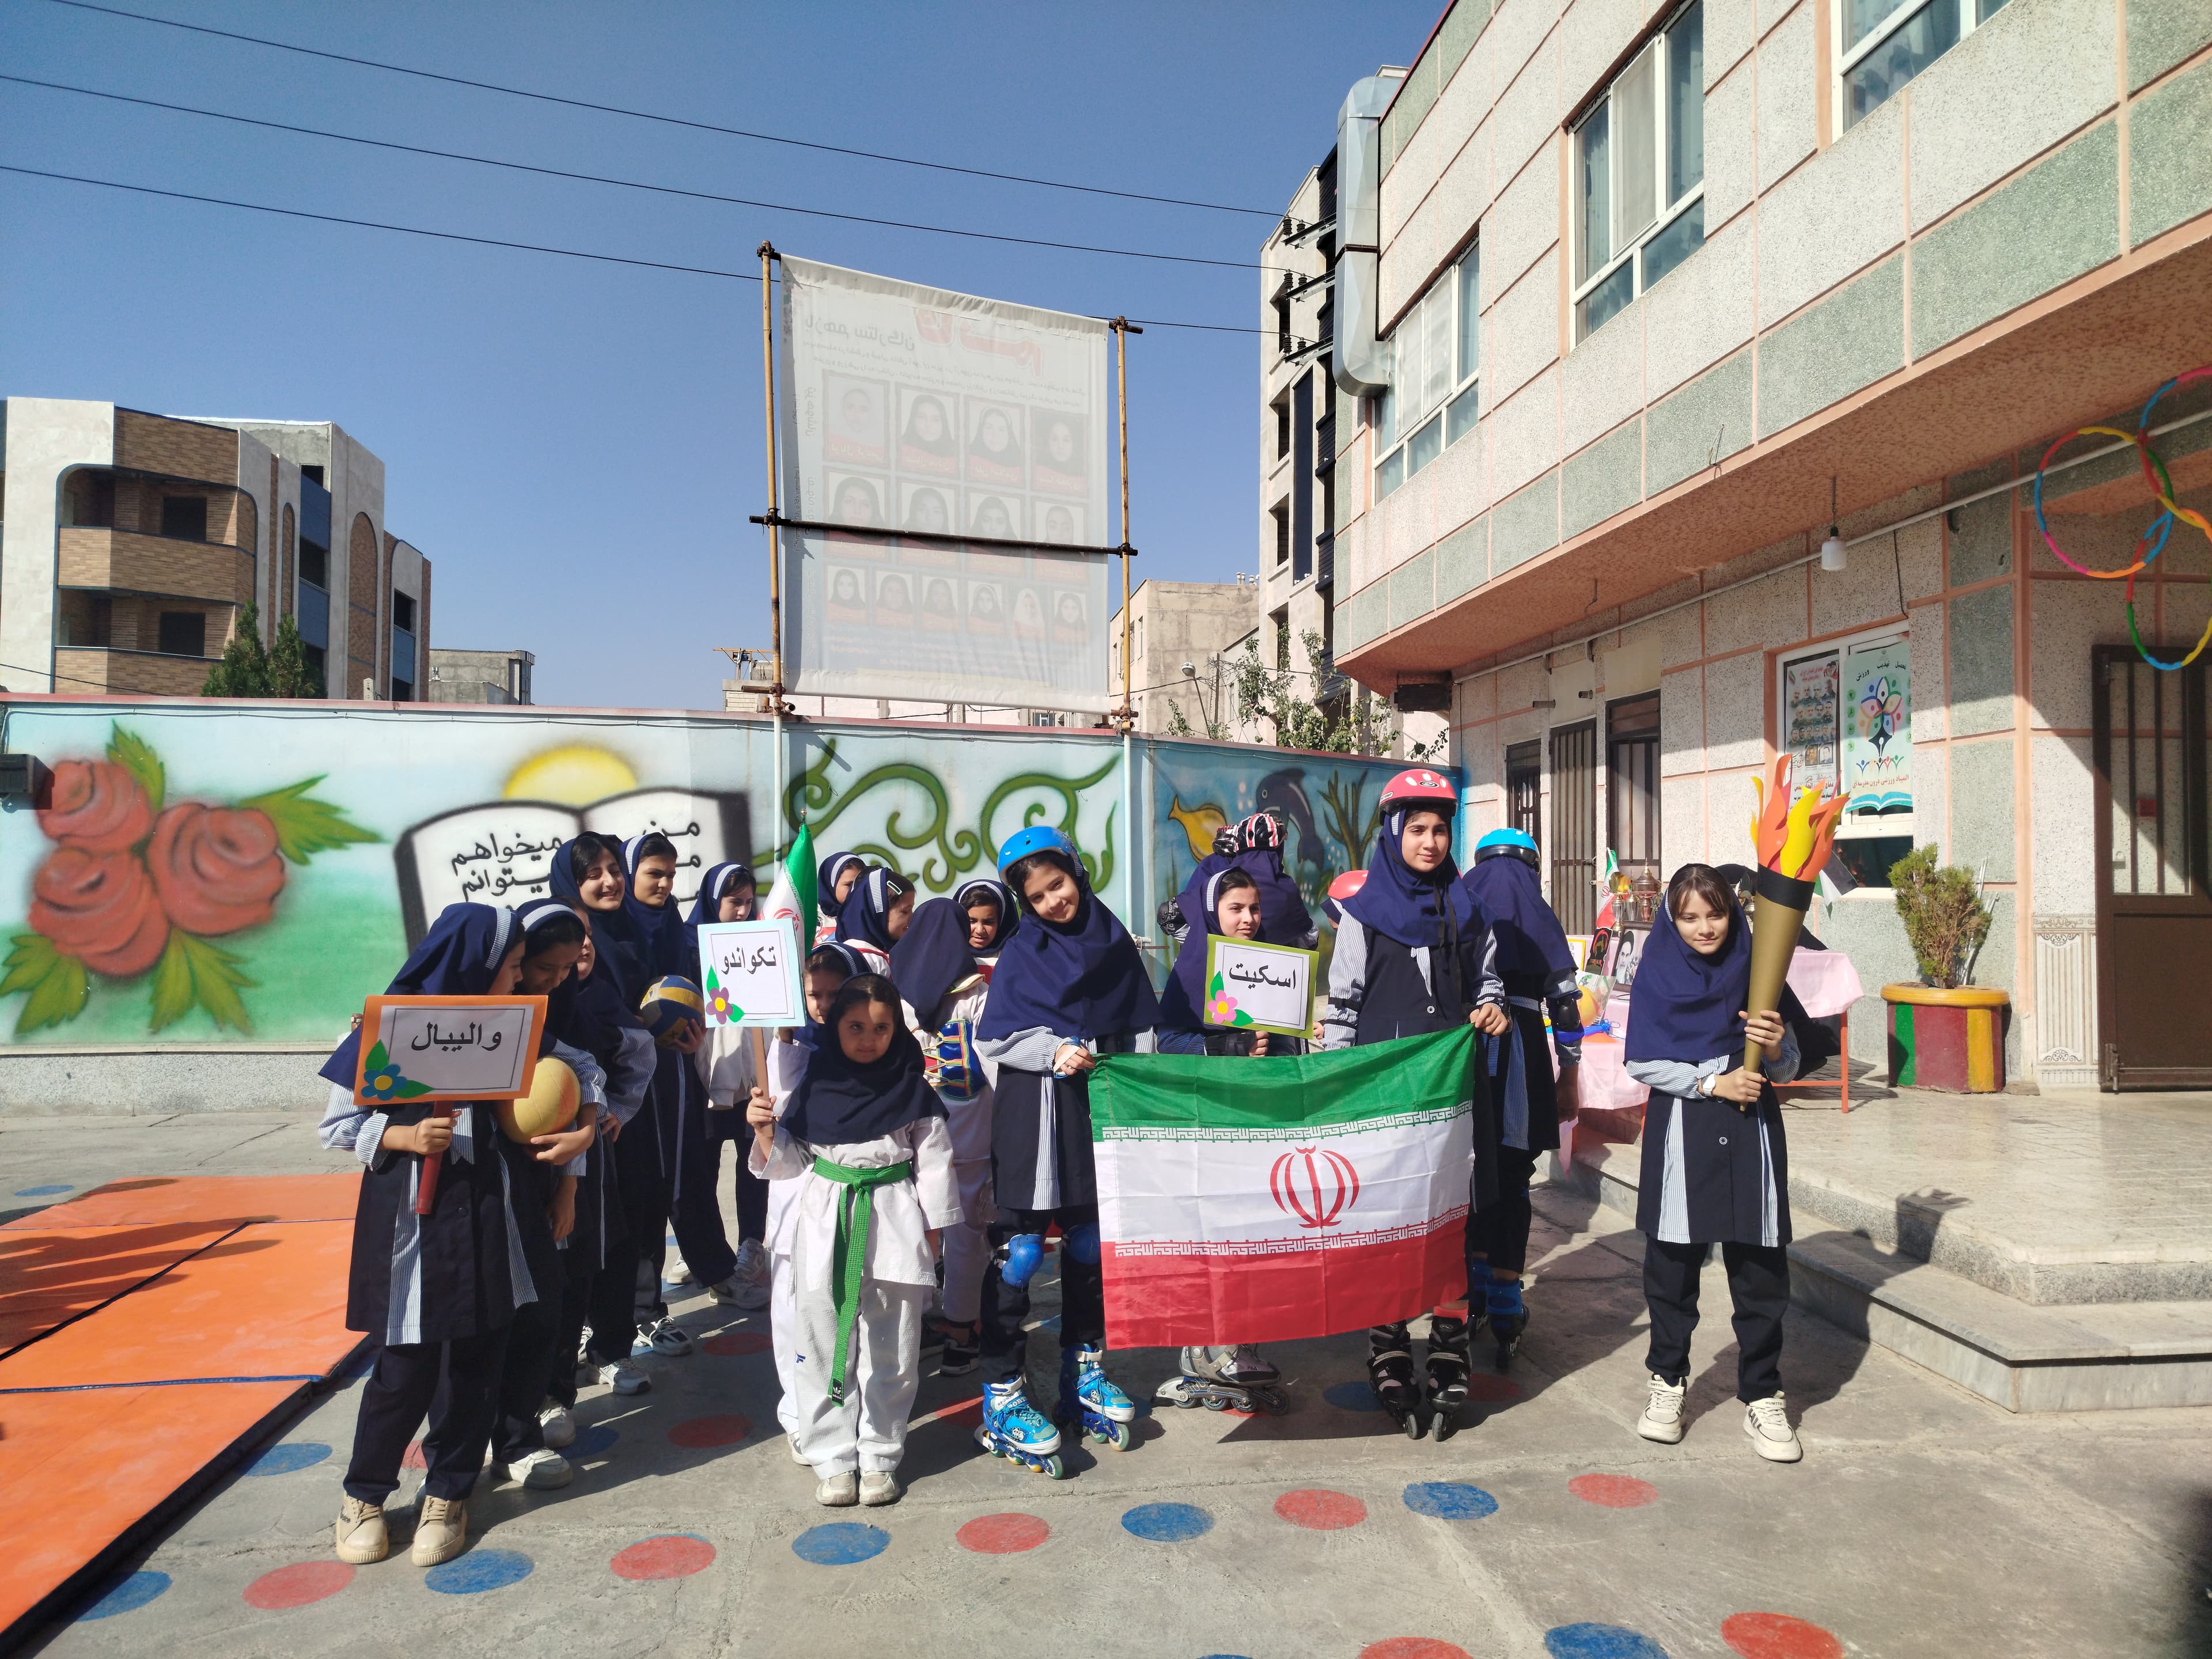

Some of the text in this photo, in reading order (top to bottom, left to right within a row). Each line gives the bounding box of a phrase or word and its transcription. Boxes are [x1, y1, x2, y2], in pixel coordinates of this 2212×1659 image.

[1857, 670, 1869, 681] ورزش
[461, 869, 550, 902] یتوانم
[721, 946, 777, 975] تکواندو
[1229, 963, 1296, 990] اسکیت
[411, 1022, 502, 1052] والیبال
